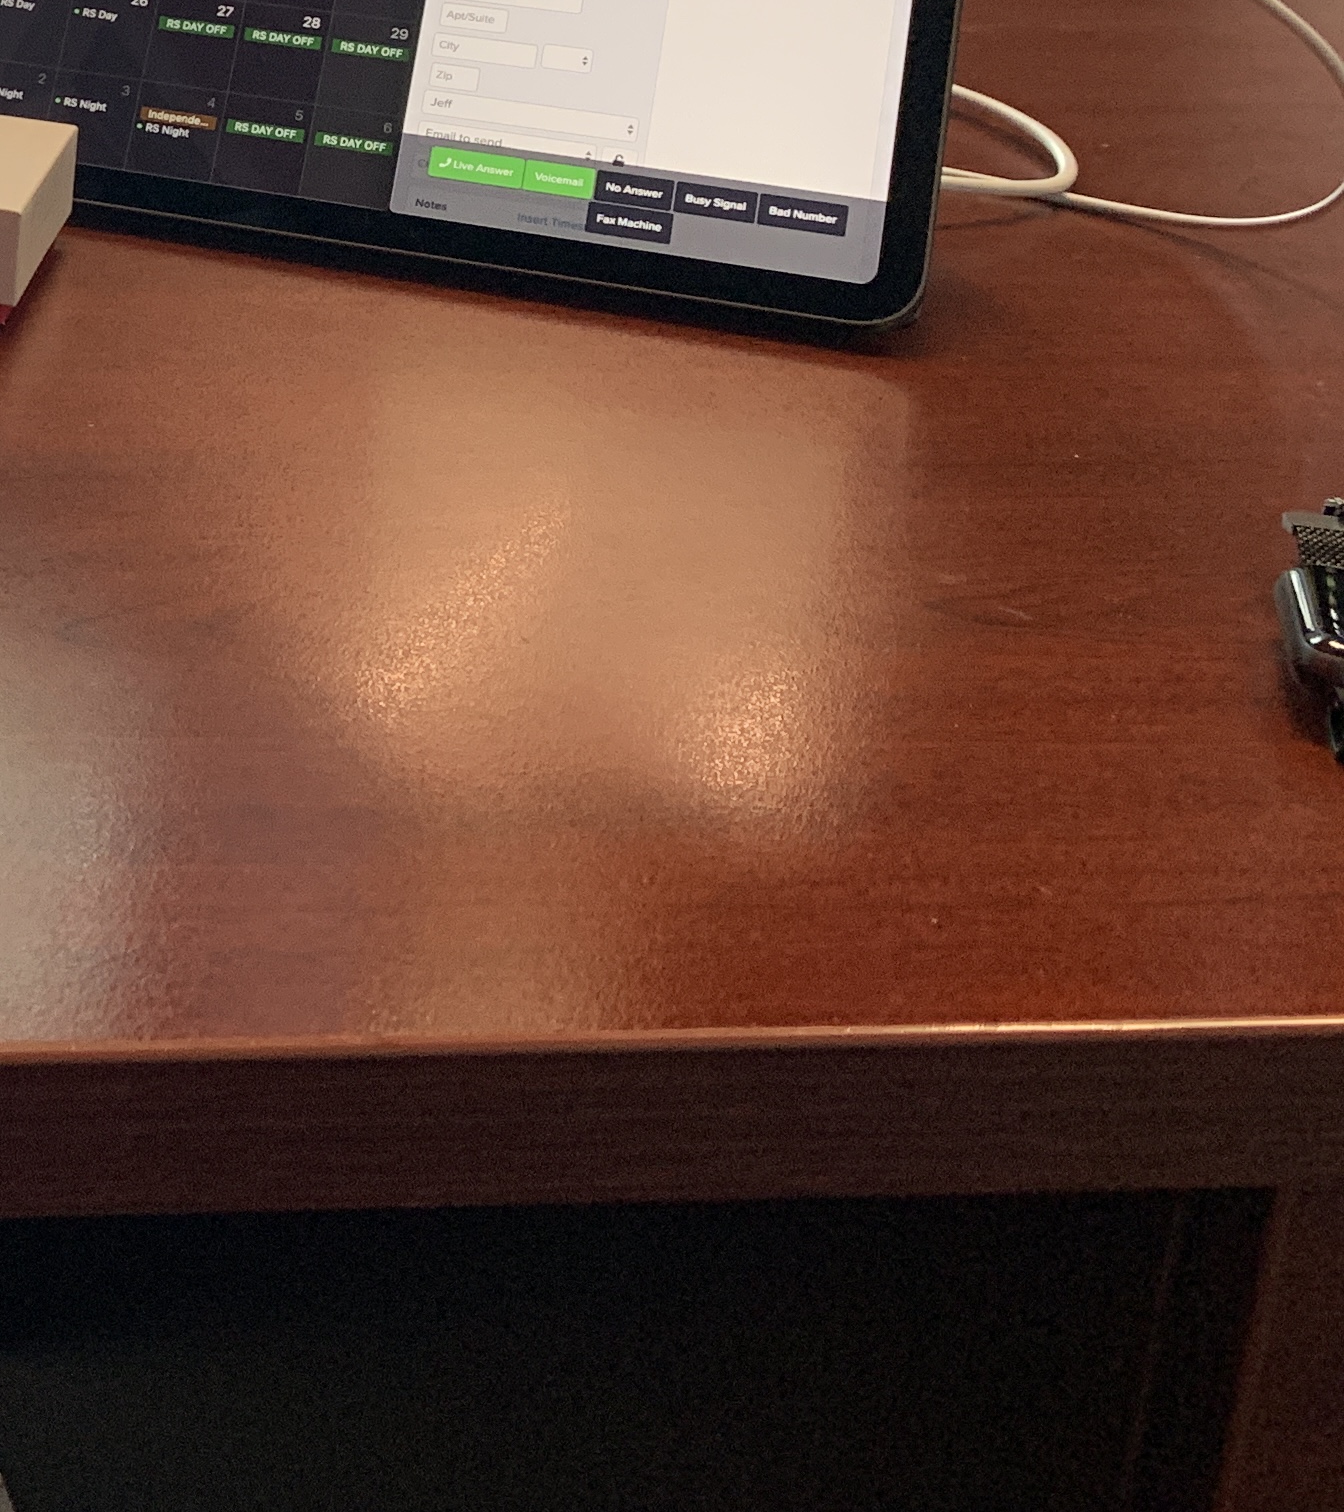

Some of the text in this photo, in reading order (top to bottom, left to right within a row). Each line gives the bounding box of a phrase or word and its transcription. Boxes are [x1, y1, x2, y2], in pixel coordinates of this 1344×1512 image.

[217, 6, 234, 17] 27
[446, 10, 495, 24] Apt/Suite
[166, 19, 227, 35] RS DAY OFF
[303, 17, 321, 28] 28
[391, 28, 408, 40] 29
[439, 41, 460, 53] City
[436, 71, 452, 82] Zip
[431, 98, 452, 109] Jeff
[453, 161, 514, 177] Live Answer
[535, 172, 584, 187] Voicemail
[606, 182, 664, 198] No Answer
[415, 199, 447, 211] Notes
[685, 194, 747, 211] Busy Signal
[769, 205, 837, 224] Bad Number
[596, 214, 662, 232] Fax Machine
